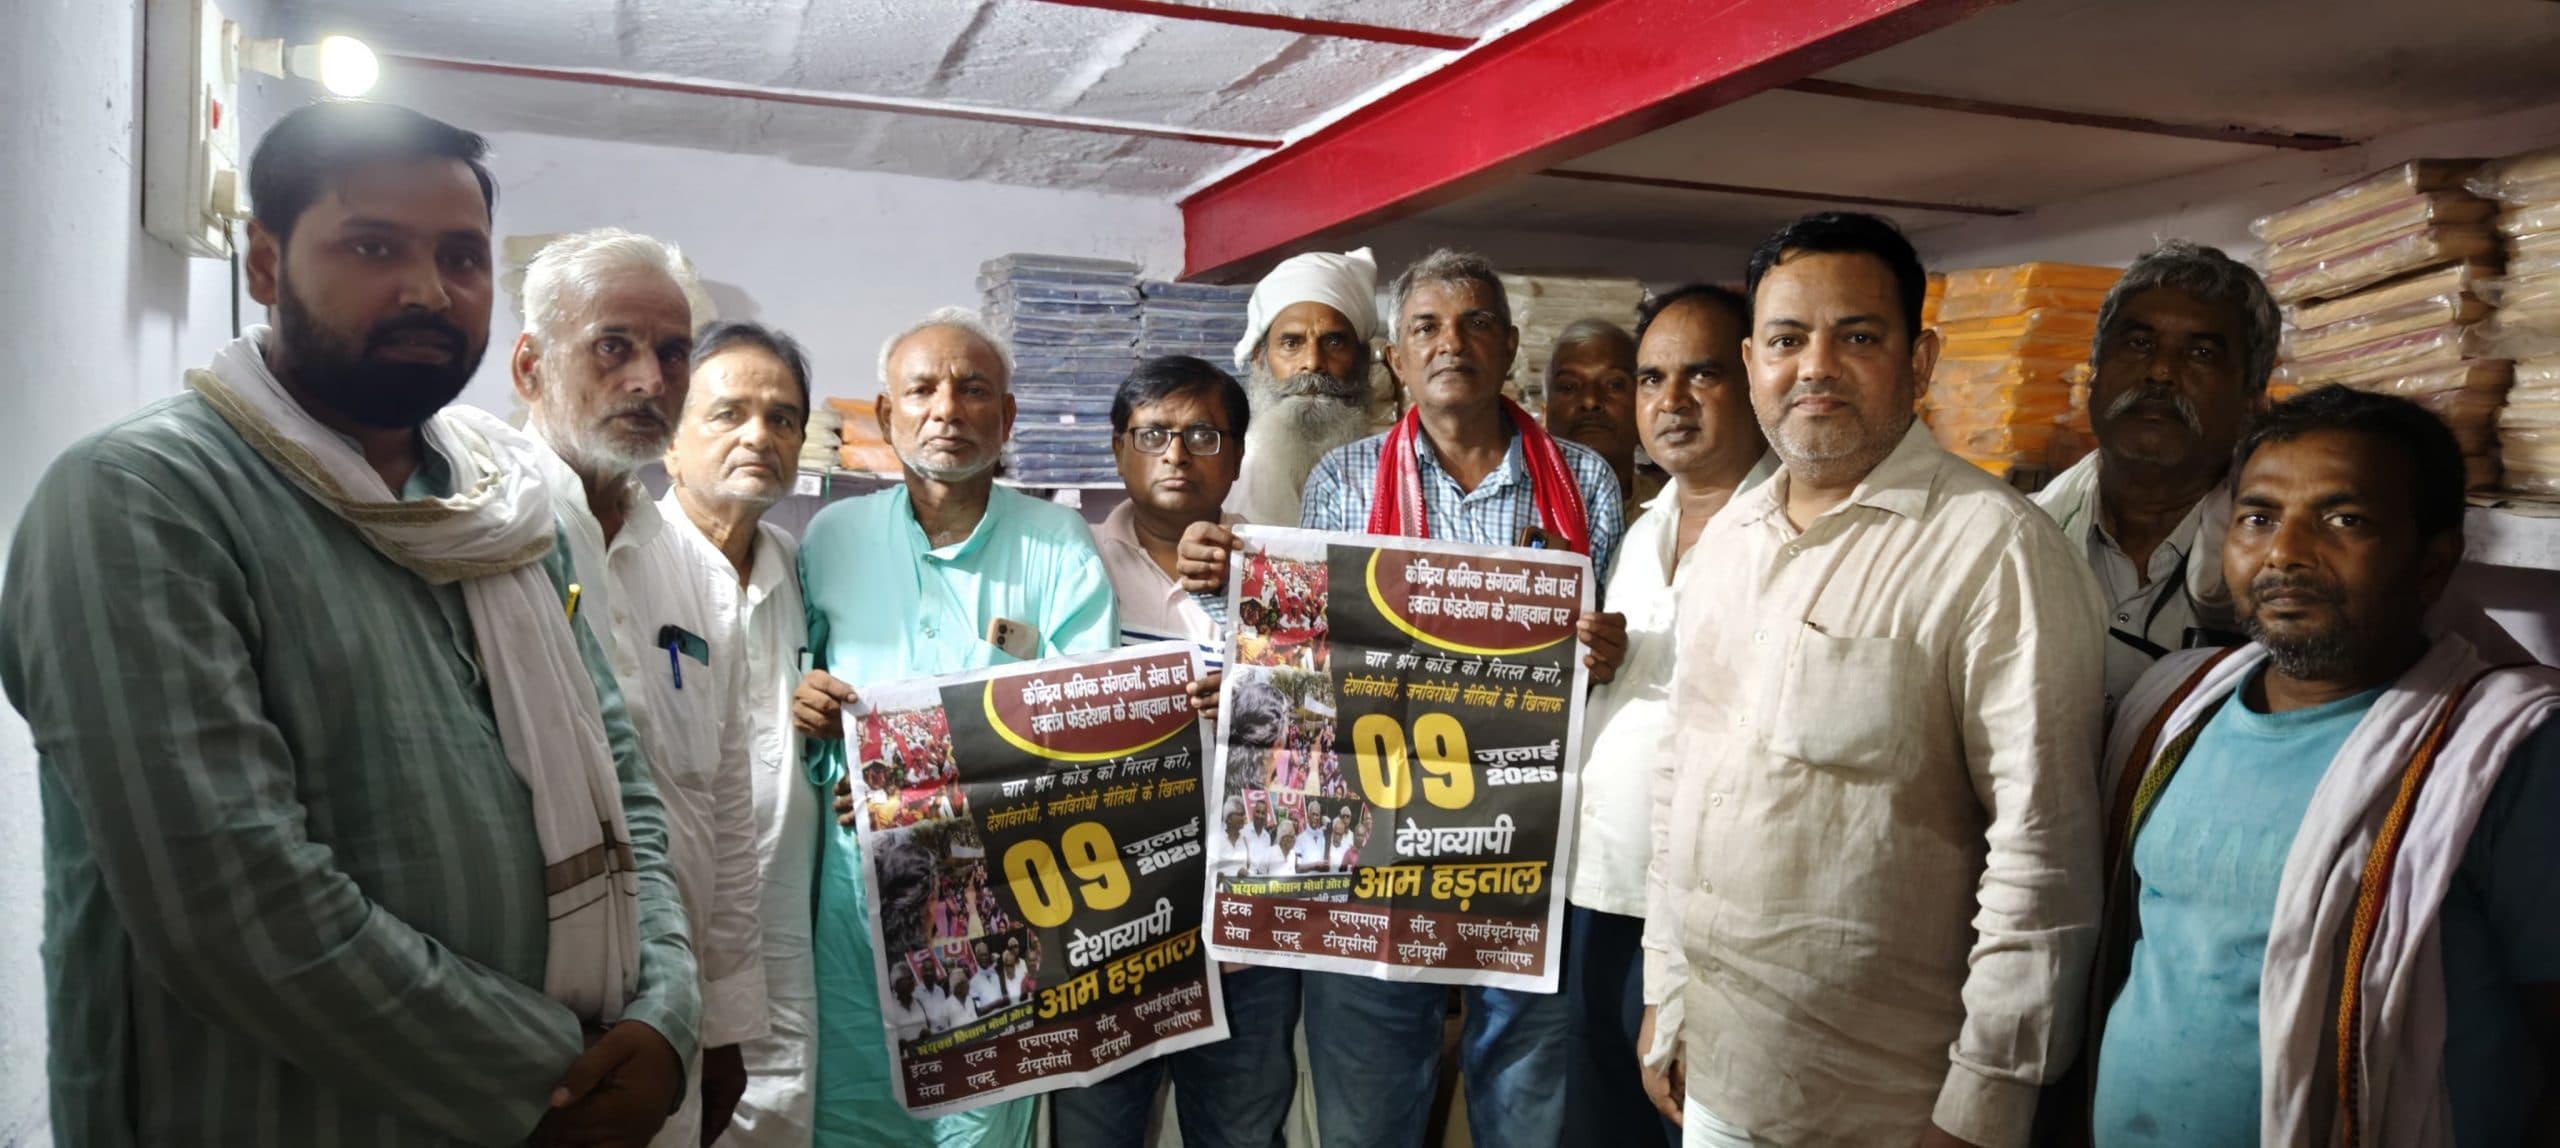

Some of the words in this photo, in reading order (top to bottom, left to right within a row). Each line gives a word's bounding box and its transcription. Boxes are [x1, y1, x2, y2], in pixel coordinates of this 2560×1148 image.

[1446, 562, 1483, 589] श्रमिक
[1485, 566, 1530, 595] संगठनों,
[1534, 570, 1558, 596] सेवा
[1560, 574, 1579, 598] एवं
[1408, 591, 1441, 615] स्वतंत्र
[1443, 592, 1489, 620] फेडरेशन
[1490, 597, 1504, 620] के
[1554, 608, 1571, 626] पर
[1064, 673, 1100, 699] श्रमिक
[1100, 665, 1146, 695] संगठनों,
[1147, 663, 1170, 688] सेवा
[1171, 659, 1189, 684] एवं
[1365, 650, 1392, 668] चार
[1396, 651, 1421, 670] श्रम
[1425, 652, 1456, 674] कोड
[1461, 655, 1482, 677] को
[1486, 656, 1527, 681] निरस्त
[1531, 662, 1562, 687] करो,
[1031, 707, 1065, 735] स्वतंत्र
[1066, 702, 1111, 730] फेडरेशन
[1113, 697, 1126, 721] के
[1172, 694, 1188, 712] पर
[1405, 680, 1460, 705] जनविरोधी
[1463, 683, 1502, 708] नीतियों
[1504, 690, 1518, 710] के
[1520, 690, 1564, 713] खिलाफ
[1001, 779, 1028, 799] चार
[1034, 773, 1056, 794] श्रम
[1062, 763, 1091, 787] कोड
[1097, 759, 1116, 781] को
[1121, 756, 1160, 778] निरस्त
[1163, 746, 1191, 770] करो,
[1352, 713, 1475, 810] 09
[1475, 739, 1560, 768] जुलाई
[1047, 789, 1099, 817] जनविरोधी
[1103, 782, 1139, 809] नीतियों
[1141, 780, 1154, 800] के
[1158, 777, 1198, 800] खिलाफ
[1486, 766, 1558, 786] 2025
[1122, 816, 1200, 857] जुलाई
[1395, 813, 1516, 857] देशव्यापी
[1003, 821, 1132, 928] 09
[1136, 840, 1201, 876] 2025
[1354, 865, 1425, 899] आम
[1431, 861, 1548, 911] हड़ताल
[1066, 897, 1173, 968] देशव्यापी
[1221, 898, 1253, 917] इंटक
[1274, 905, 1307, 923] एटक
[1329, 909, 1389, 932] एचएमएस
[1409, 914, 1436, 939] सीटू
[1457, 920, 1540, 946] एआईयूटीयूसी
[1224, 921, 1251, 941] सेवा
[1272, 930, 1303, 950] एक्टू
[1322, 931, 1378, 955] टीयूसीसी
[1398, 940, 1448, 965] यूटीयूसी
[1475, 946, 1534, 970] एलपीएफ
[1038, 969, 1099, 1019] आम
[1105, 926, 1201, 996] हड़ताल
[910, 1060, 944, 1079] इंटक
[964, 1046, 998, 1067] एटक
[1018, 1028, 1079, 1053] एचएमएस
[917, 1082, 945, 1098] सेवा
[1016, 1052, 1072, 1075] टीयूसीसी
